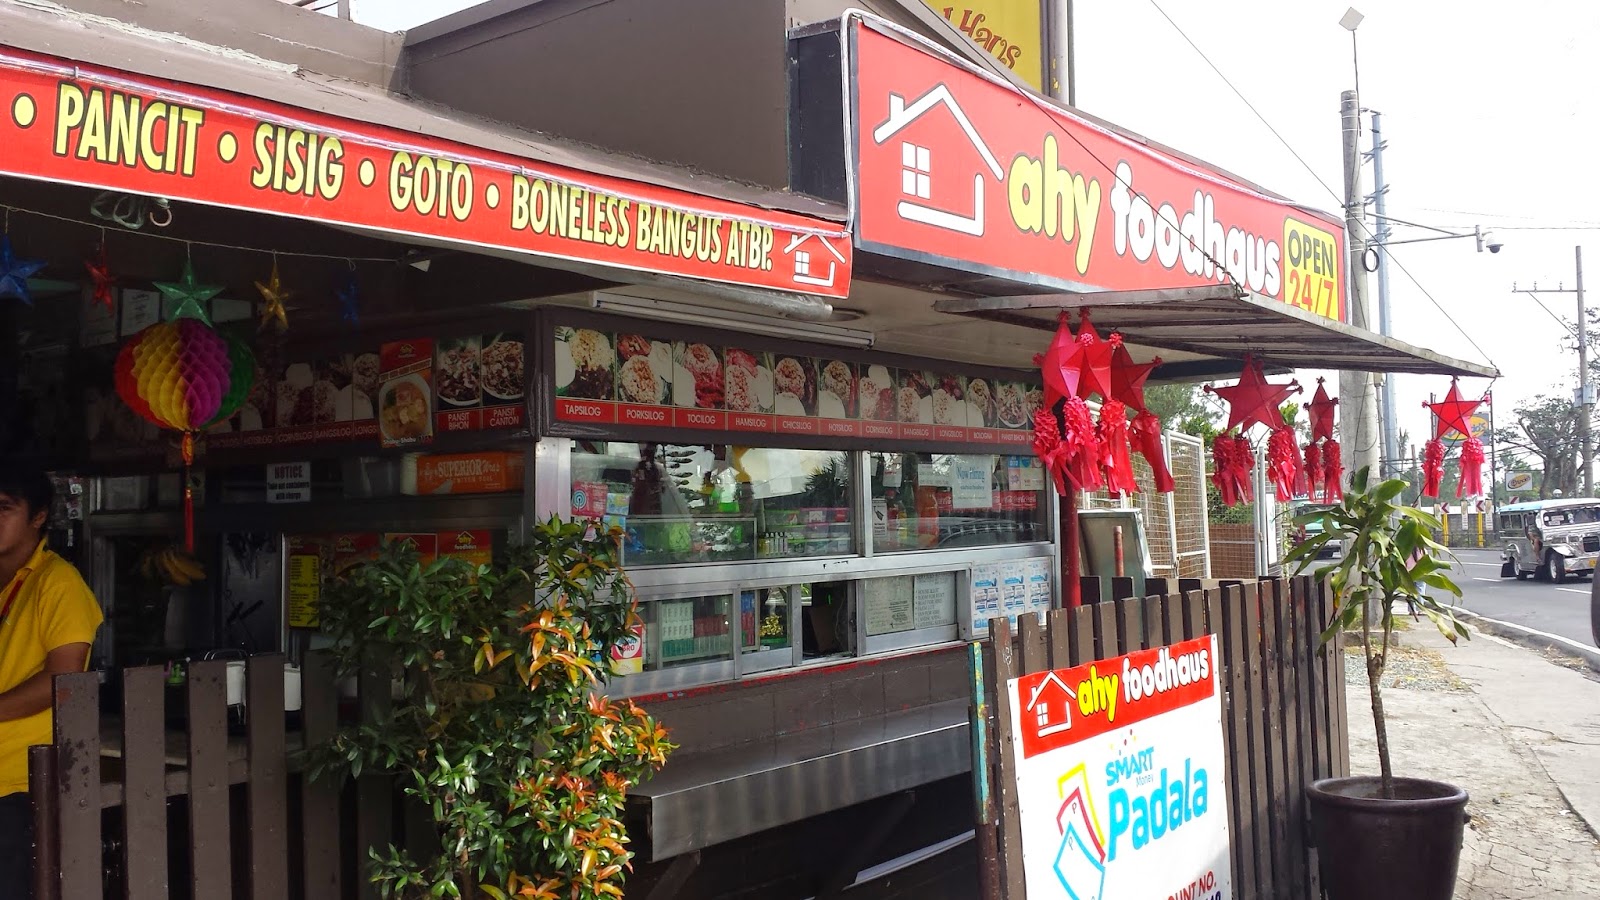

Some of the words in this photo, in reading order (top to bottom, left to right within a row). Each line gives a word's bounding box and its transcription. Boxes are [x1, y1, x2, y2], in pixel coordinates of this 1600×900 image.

[54, 82, 204, 177] PANCIT
[252, 123, 344, 200] SISIG
[389, 151, 473, 221] GOTO
[511, 174, 631, 248] BONELESS
[636, 204, 722, 264] BANGUS
[726, 221, 774, 271] ATBP.
[1008, 133, 1100, 276] ahy
[1110, 160, 1281, 298] foodhaus
[1288, 229, 1334, 279] OPEN
[1289, 271, 1334, 317] 24/7
[448, 412, 469, 421] PANSIT
[493, 408, 515, 416] PANSIT
[565, 404, 601, 417] TAPSILOG
[626, 409, 665, 421] PORKSILOG
[448, 421, 470, 430] BIHON
[490, 416, 519, 427] CANTON
[687, 413, 716, 425] TOCILOG
[735, 417, 766, 428] HAMSILOG
[354, 425, 377, 436] LONGS
[274, 465, 303, 479] NOTICE
[437, 459, 482, 477] SUPERIOR
[1077, 664, 1119, 722] ahy
[1122, 647, 1209, 703] foodhaus
[1105, 746, 1155, 787] SMART
[1135, 774, 1154, 787] Money
[1107, 757, 1208, 862] Padala
[1198, 870, 1217, 897] NO.
